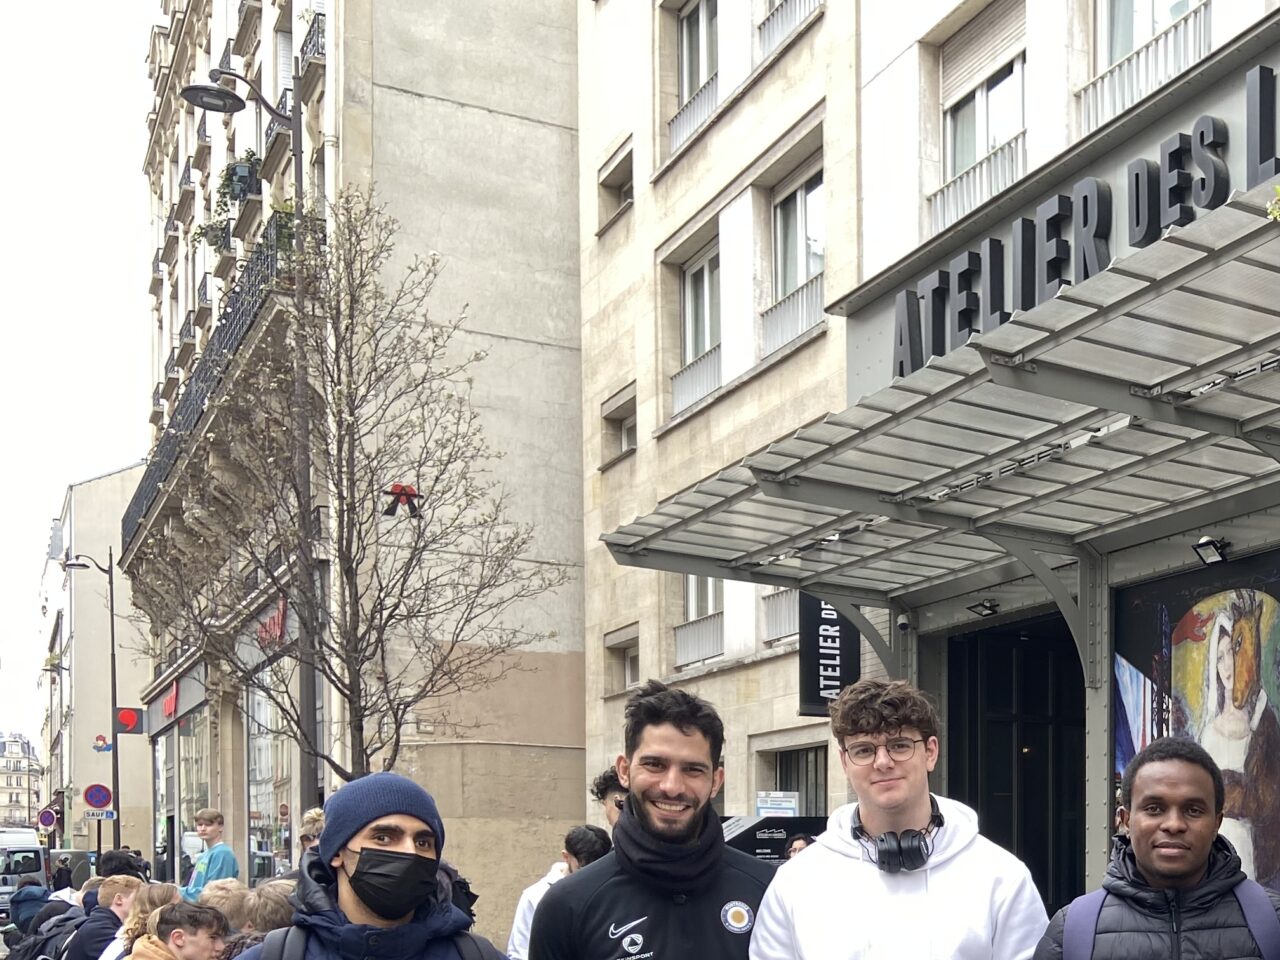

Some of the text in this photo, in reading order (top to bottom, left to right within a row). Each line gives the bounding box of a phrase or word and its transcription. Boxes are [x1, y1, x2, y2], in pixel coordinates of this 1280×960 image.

[893, 177, 1112, 378] ATELIER
[1128, 115, 1228, 248] DES
[819, 600, 840, 700] ATELIER DE
